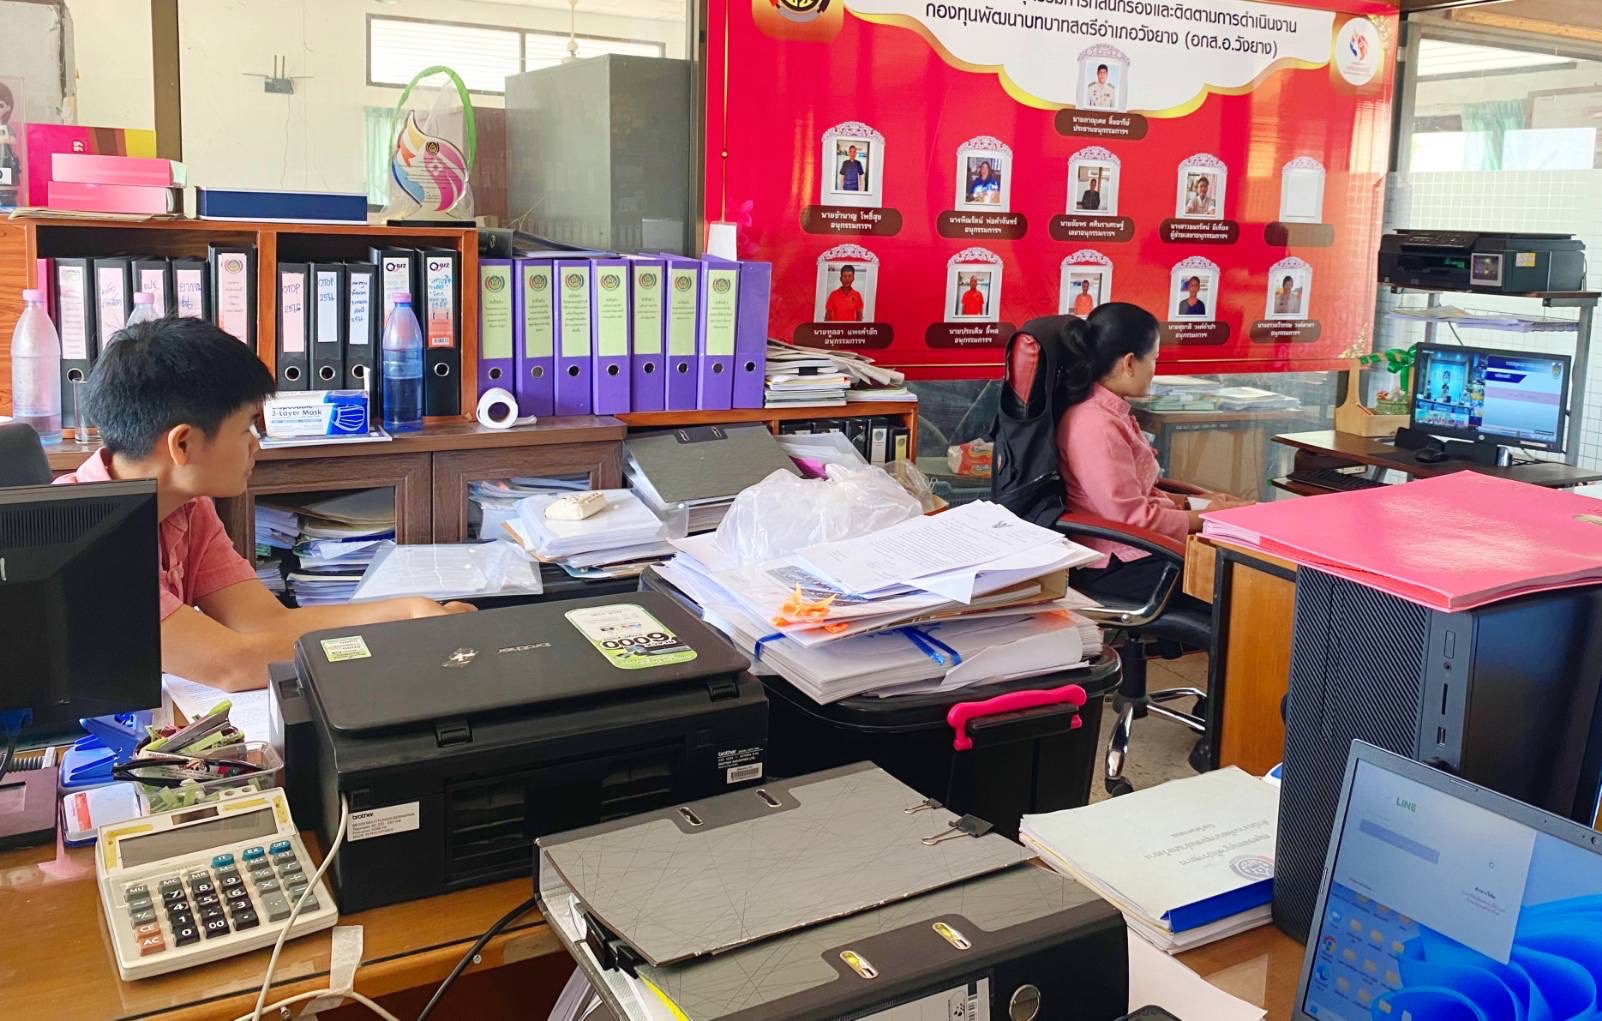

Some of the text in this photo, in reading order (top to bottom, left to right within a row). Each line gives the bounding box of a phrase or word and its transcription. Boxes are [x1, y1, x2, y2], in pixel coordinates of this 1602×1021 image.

[926, 3, 1278, 59] กองทุนพัฒนาบทบาทสตรีอำเภอวังยาง (อกส.อ.วังยาง)
[601, 632, 669, 650] 6000
[1396, 796, 1416, 813] LINE
[208, 920, 225, 929] 00
[181, 928, 192, 936] 0
[143, 937, 160, 946] AC
